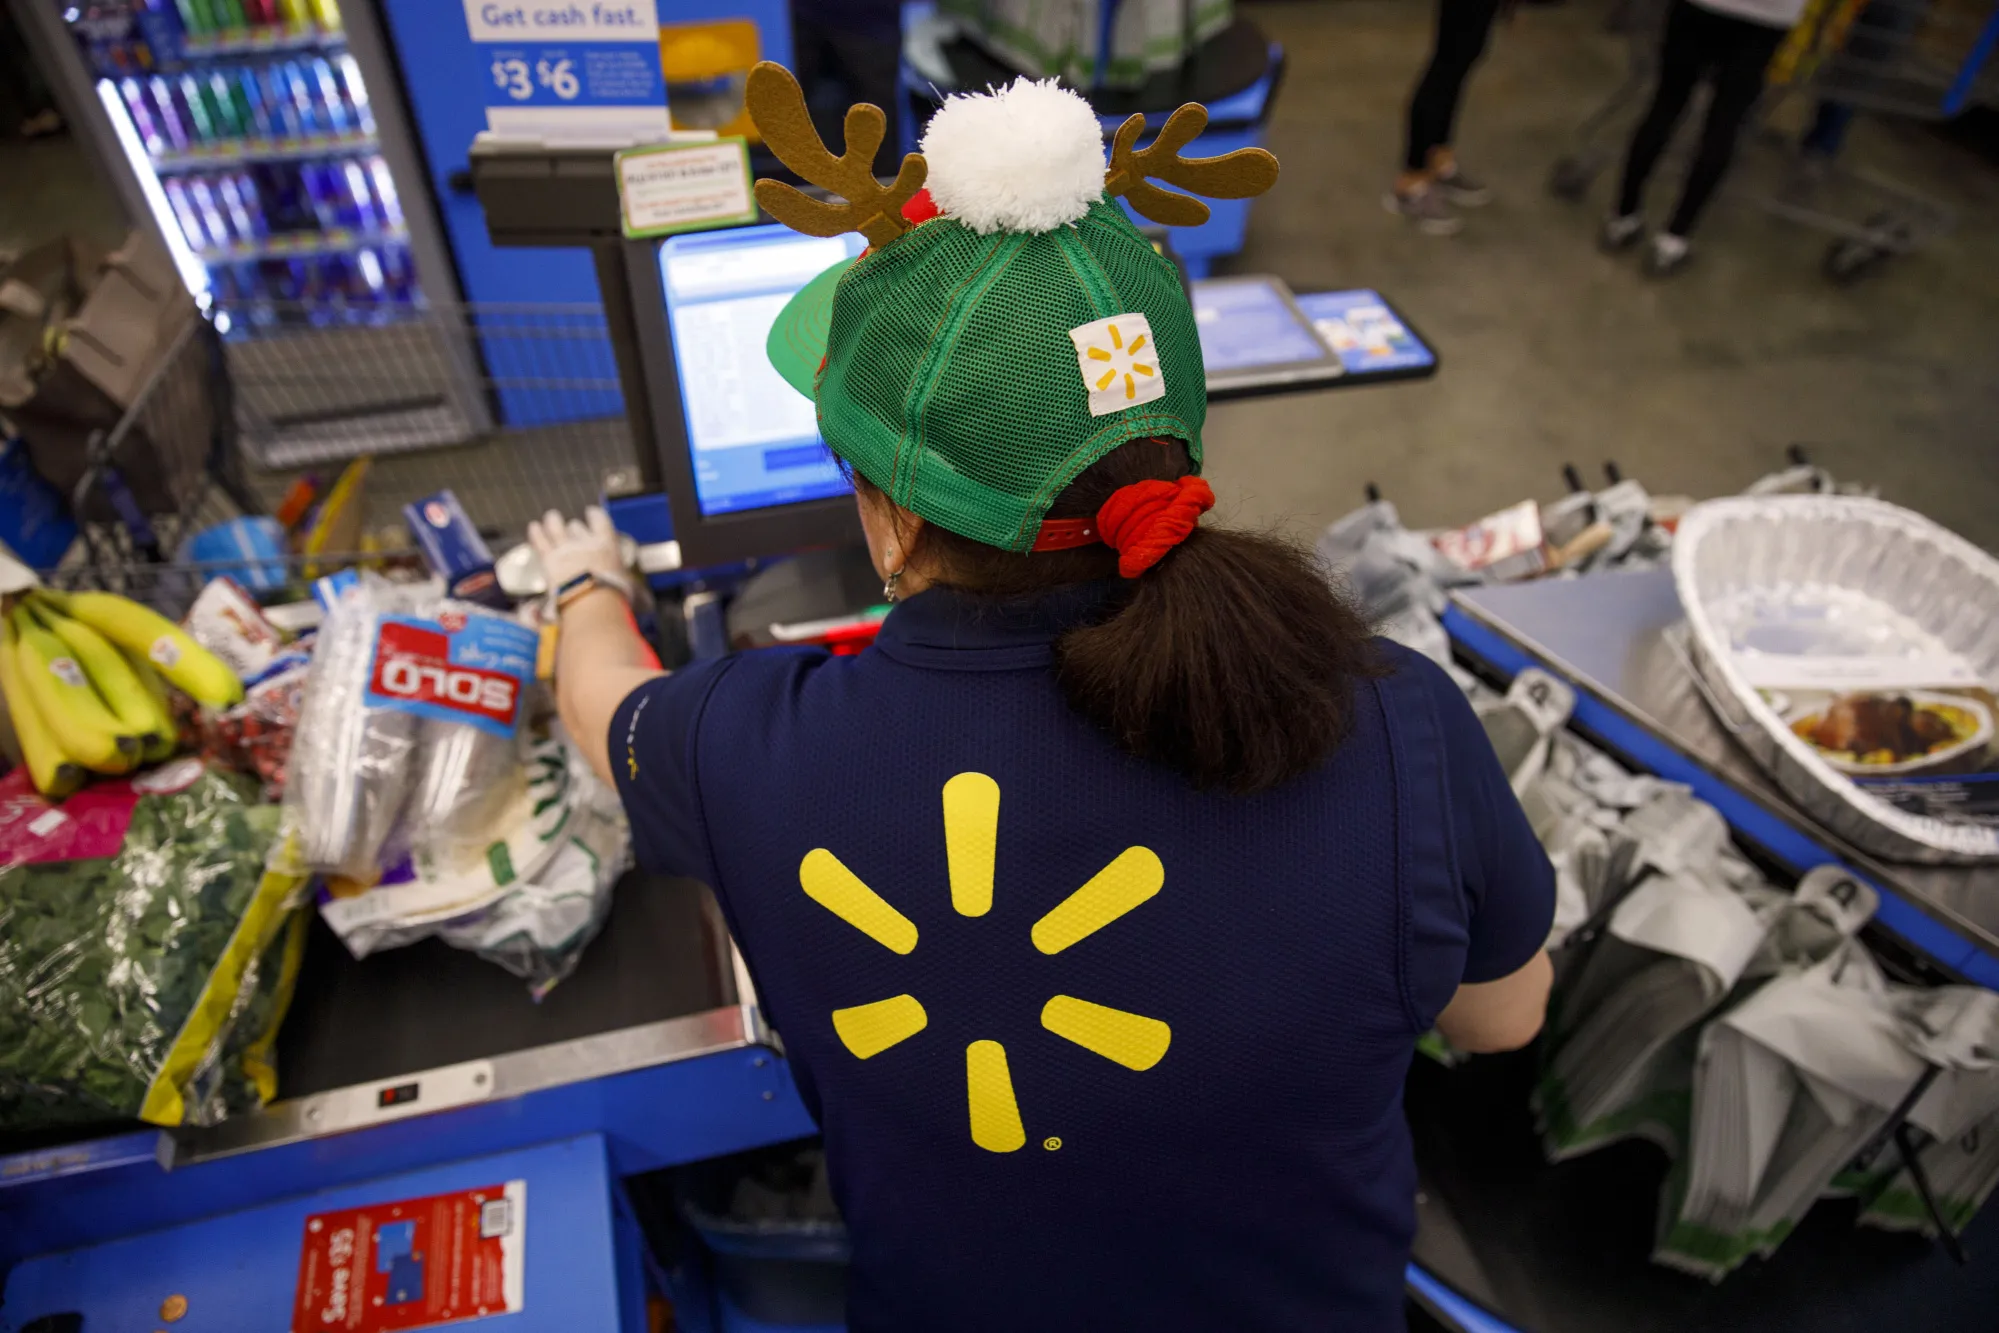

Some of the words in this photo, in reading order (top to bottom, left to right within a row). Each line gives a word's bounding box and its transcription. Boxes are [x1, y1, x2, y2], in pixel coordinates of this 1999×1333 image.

[481, 3, 526, 27] Get
[533, 4, 587, 27] cash
[593, 4, 645, 27] fast.
[490, 59, 534, 100] $3
[536, 59, 580, 100] $6
[381, 660, 514, 711] SOLO
[321, 1267, 351, 1324] Save
